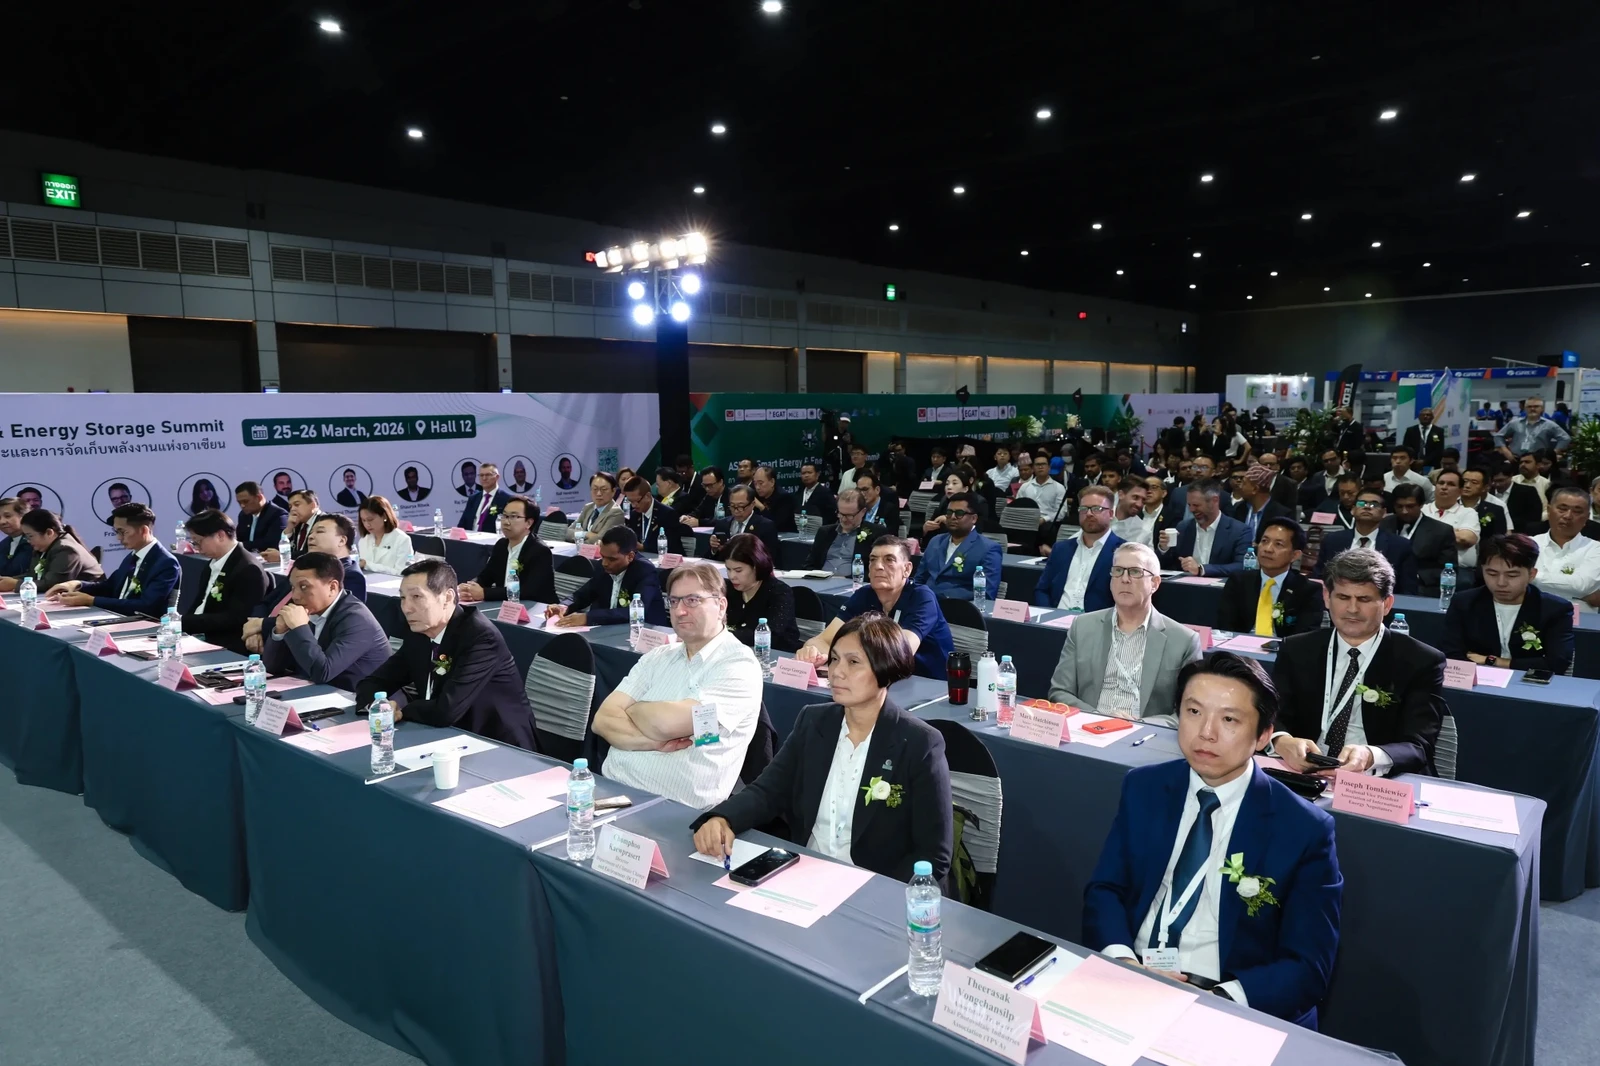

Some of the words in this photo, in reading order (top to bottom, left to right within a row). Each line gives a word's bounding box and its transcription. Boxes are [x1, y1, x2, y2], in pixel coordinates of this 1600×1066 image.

[46, 188, 77, 200] EXIT
[11, 424, 78, 440] Energy
[86, 422, 155, 437] Storage
[161, 420, 224, 434] Summit
[273, 424, 316, 439] 25-26
[322, 423, 370, 438] March,
[373, 422, 404, 436] 2026
[431, 420, 457, 433] Hall
[460, 420, 472, 432] 12
[779, 458, 802, 468] Energy
[1020, 712, 1032, 721] Mark
[1033, 716, 1059, 727] Hutchinson
[1340, 780, 1364, 789] Joseph
[1365, 784, 1407, 798] Tomkiewicz
[1345, 788, 1366, 796] Regional
[1377, 794, 1399, 802] President
[1341, 793, 1366, 801] Association
[1372, 799, 1403, 809] International
[1348, 800, 1364, 808] Energy
[1366, 803, 1393, 813] Negotiators
[609, 843, 641, 861] Kaewprasert
[967, 976, 1011, 1004] Theerasak
[958, 987, 1015, 1023] Vongchansilp
[944, 1005, 955, 1016] Thai
[956, 1010, 990, 1032] Photovoltaic
[991, 1024, 1020, 1047] Industries
[952, 1020, 983, 1040] Association
[983, 1035, 1006, 1051] (TPVA)
